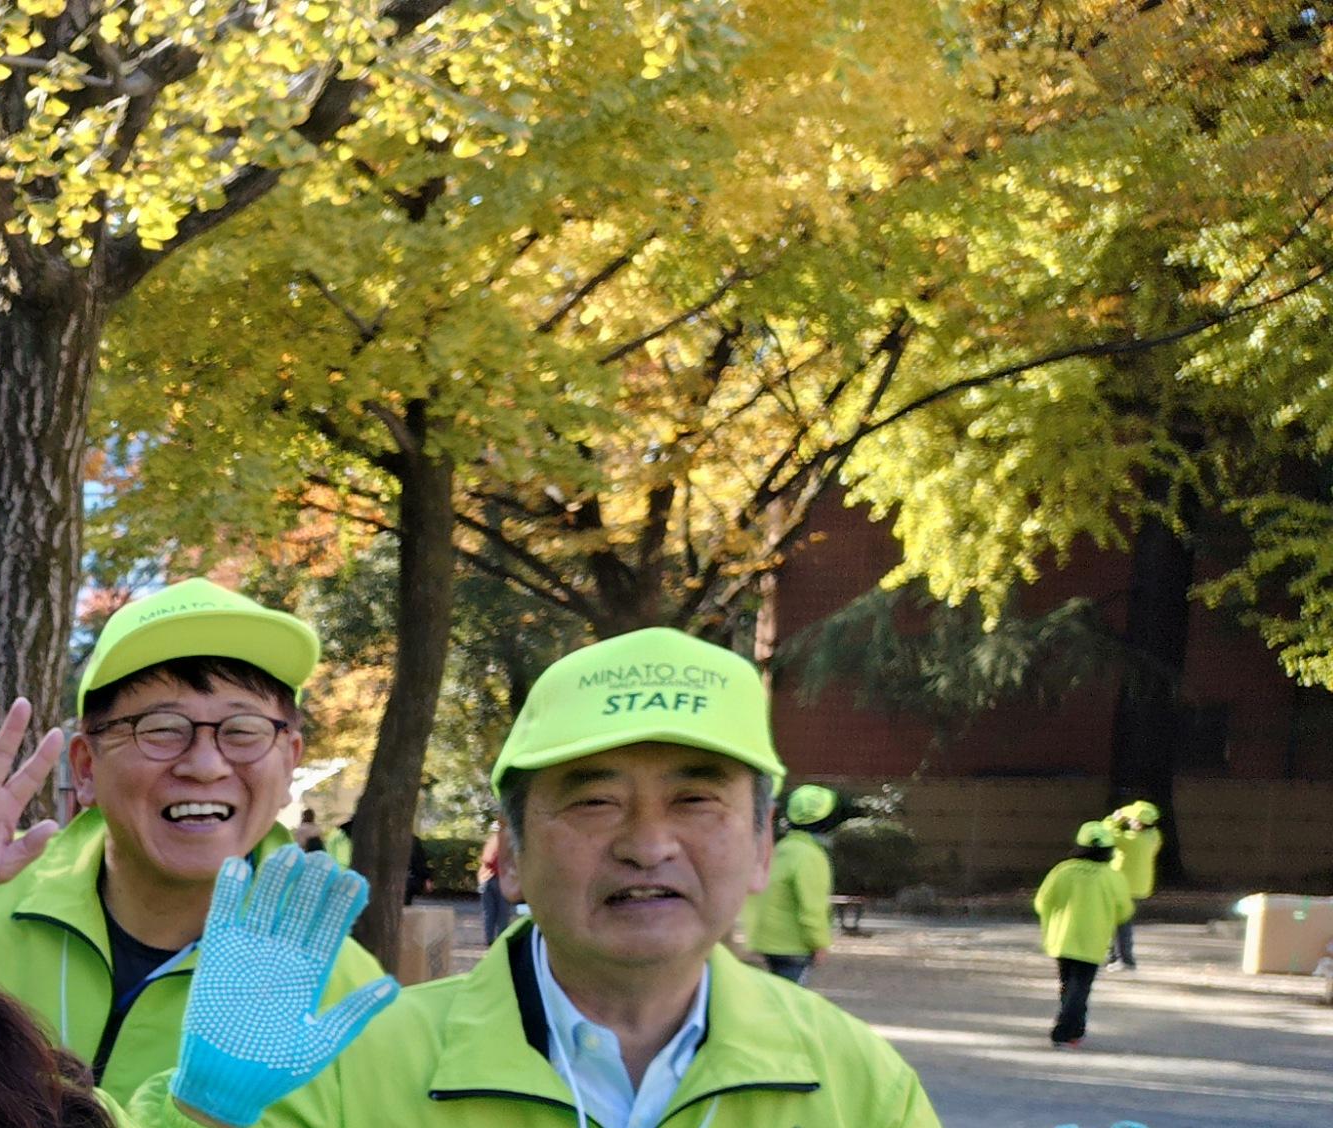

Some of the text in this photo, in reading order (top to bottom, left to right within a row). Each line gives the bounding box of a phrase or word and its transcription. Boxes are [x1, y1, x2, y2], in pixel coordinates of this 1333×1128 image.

[578, 662, 731, 690] MINATO CITY
[602, 692, 708, 715] STAFF
